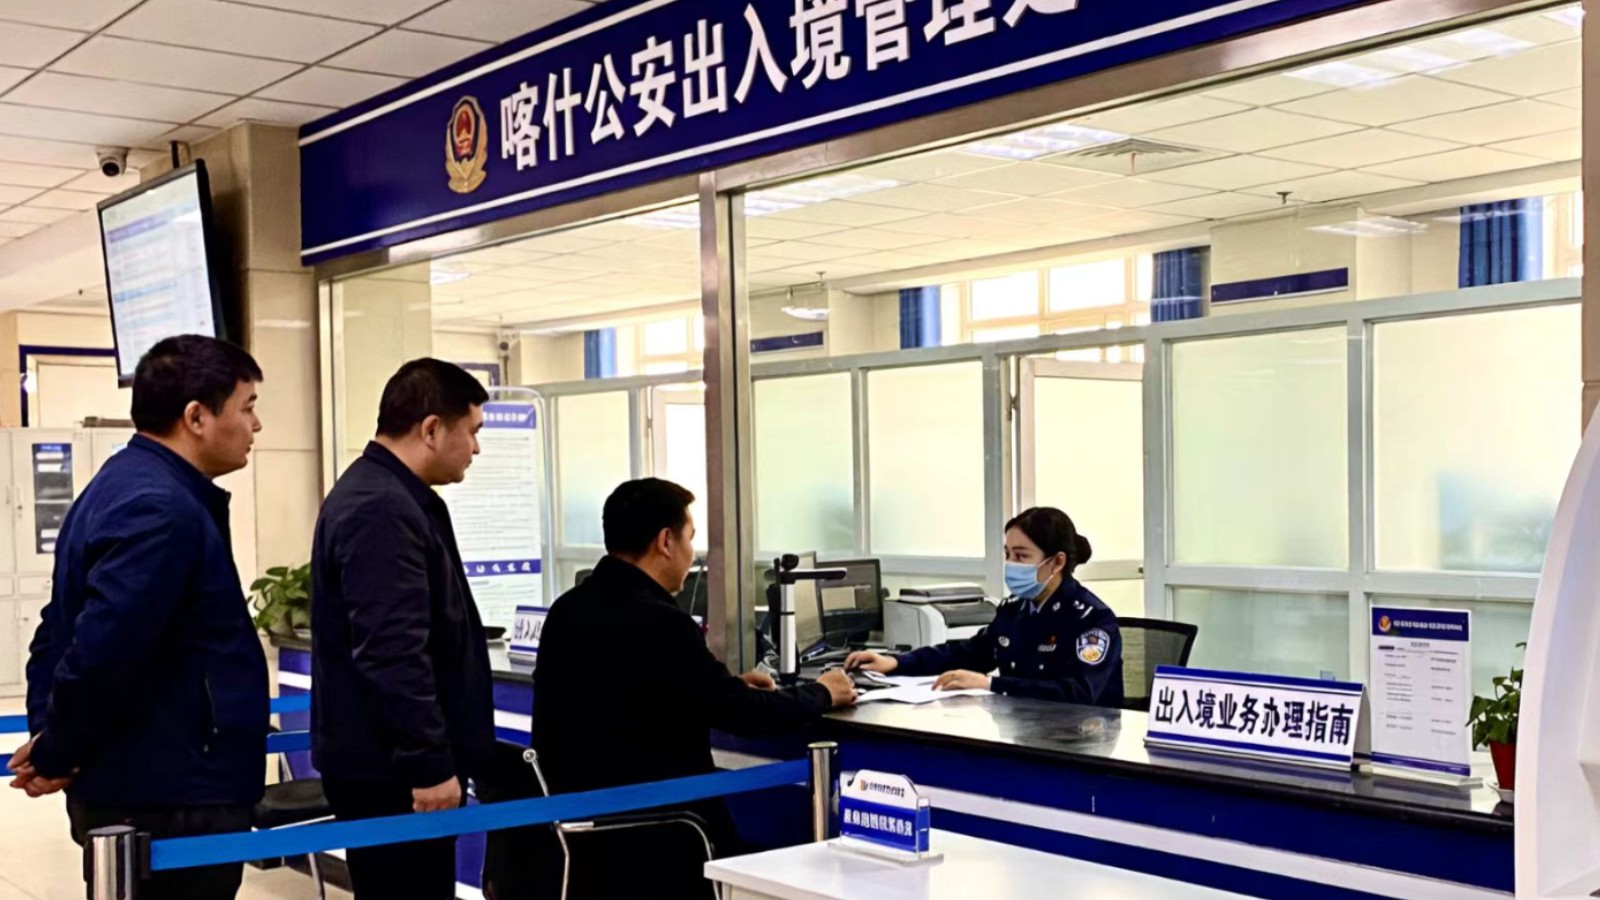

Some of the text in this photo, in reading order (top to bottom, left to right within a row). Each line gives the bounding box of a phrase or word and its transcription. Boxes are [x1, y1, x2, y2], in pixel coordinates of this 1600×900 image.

[500, 0, 1077, 171] 喀什公安出入境管
[1155, 685, 1354, 745] 出入境业务办理指南
